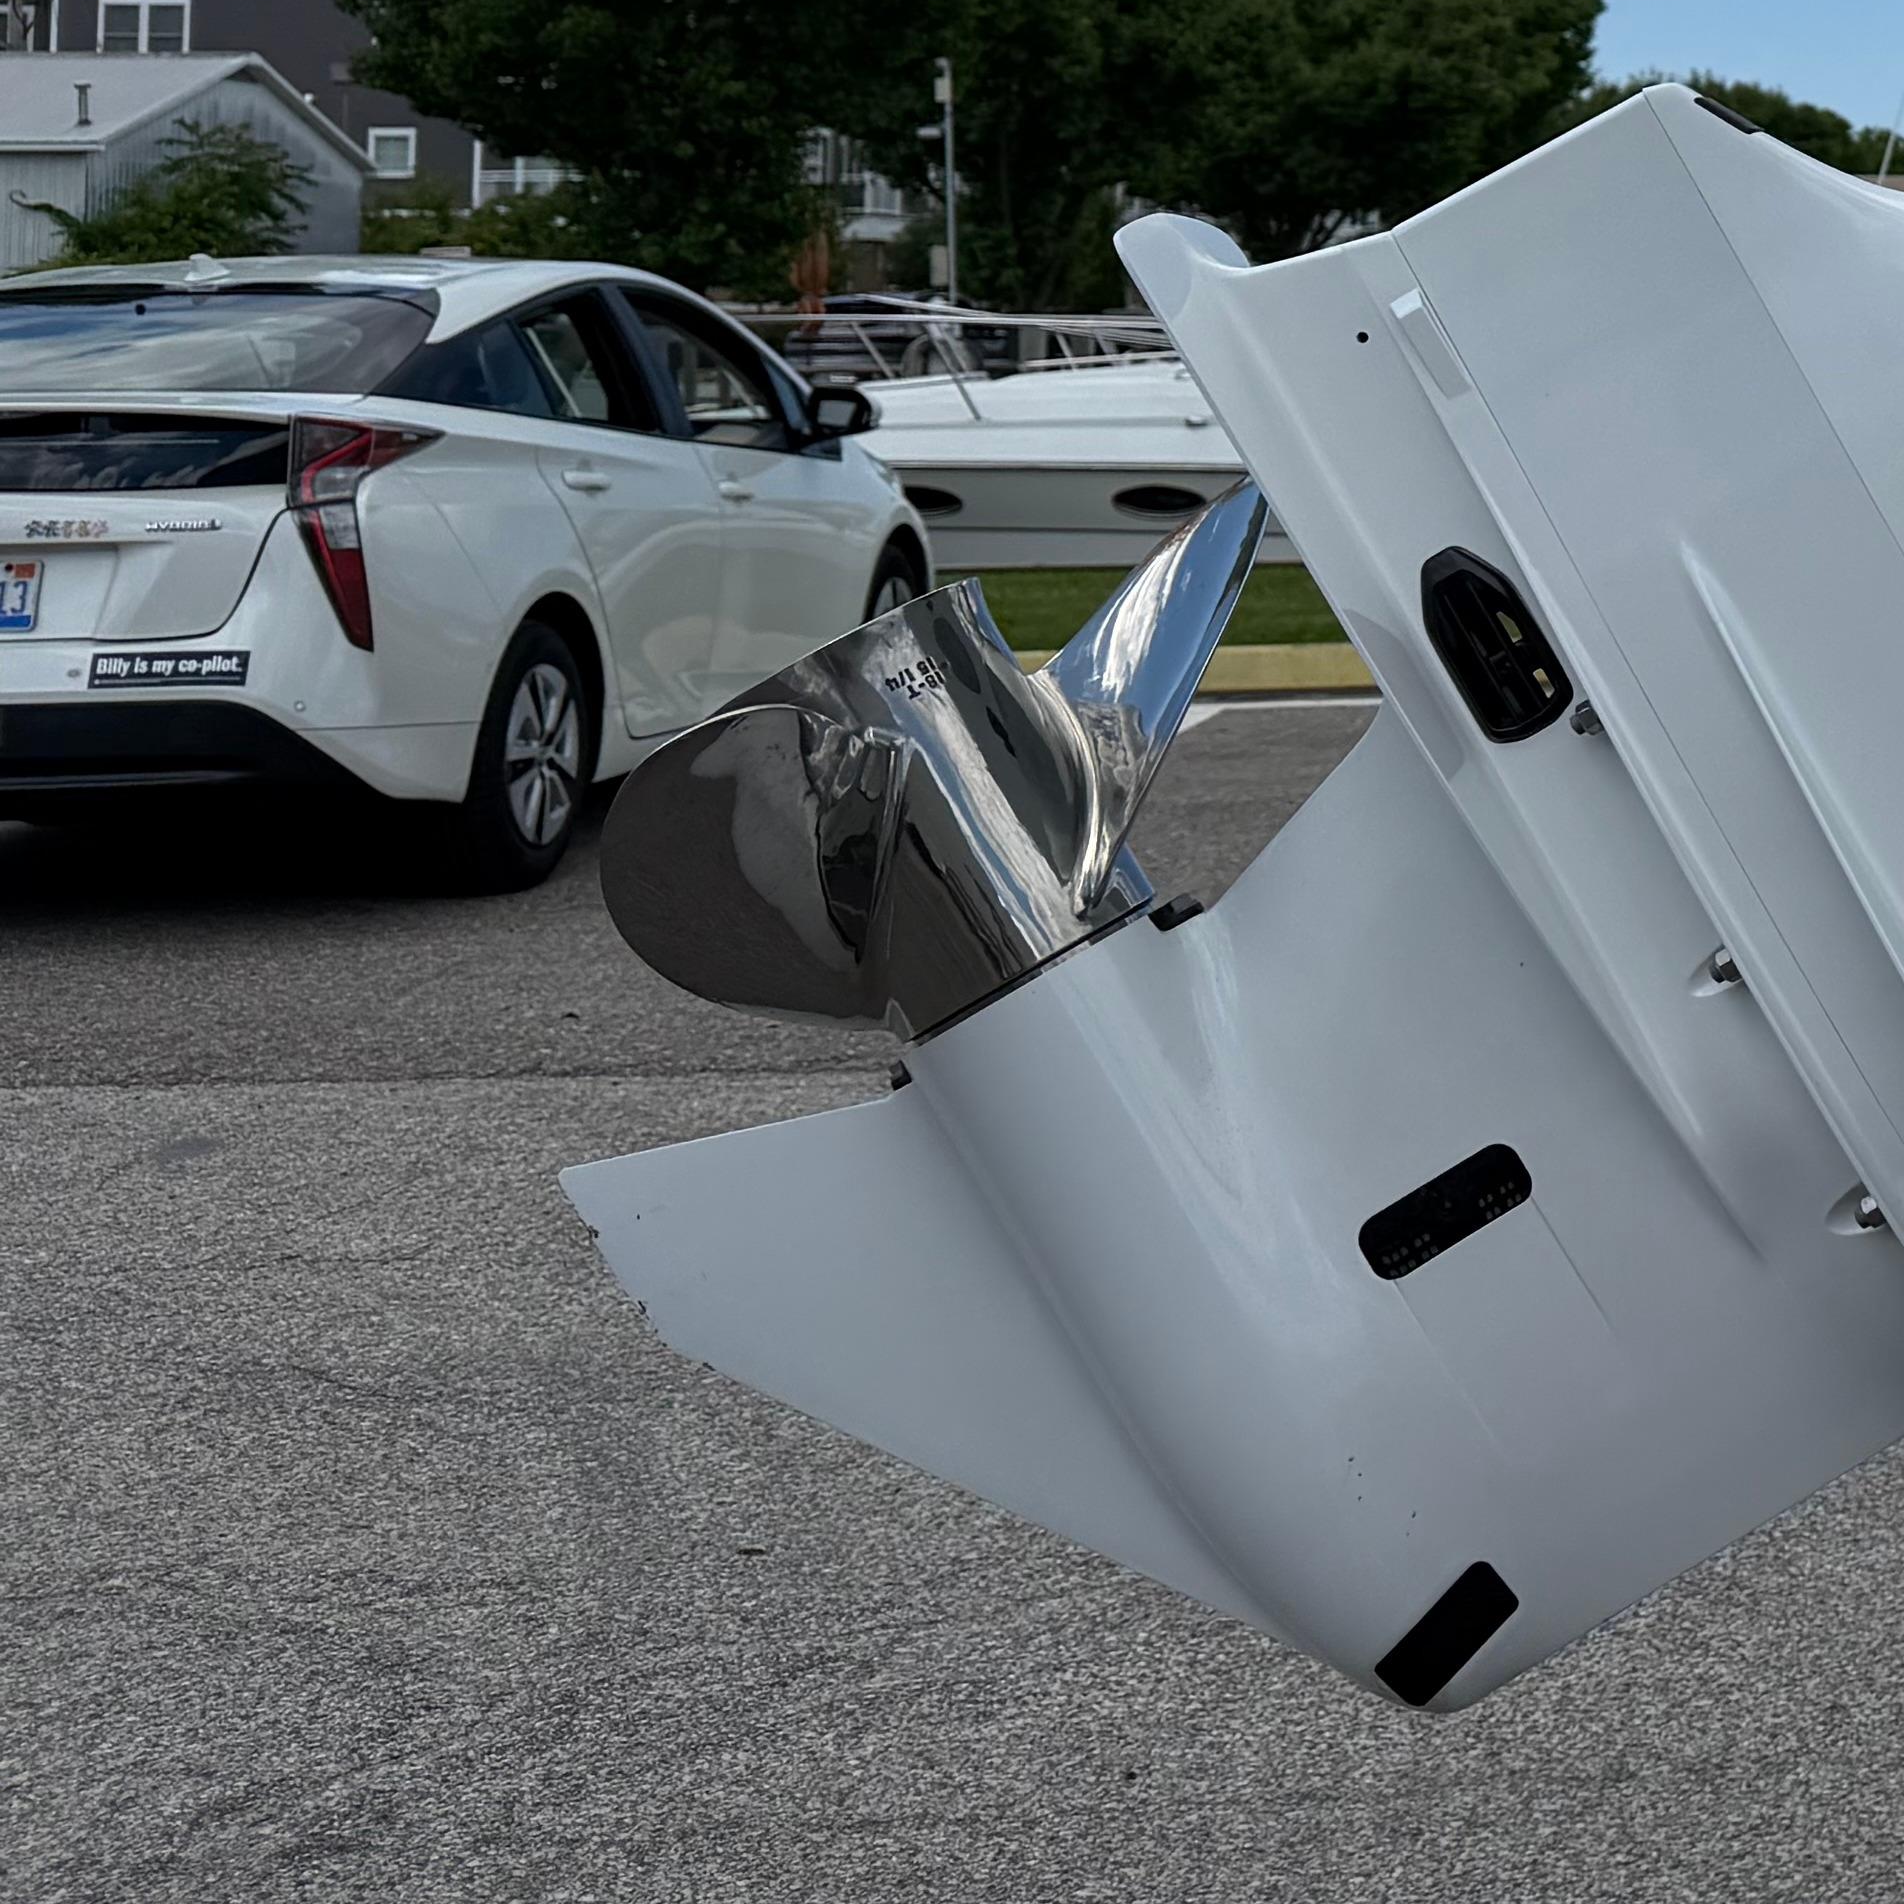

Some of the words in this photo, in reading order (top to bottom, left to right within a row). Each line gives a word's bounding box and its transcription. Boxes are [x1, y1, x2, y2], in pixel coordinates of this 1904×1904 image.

[95, 657, 131, 677] Billy
[134, 656, 148, 675] is
[152, 658, 175, 676] my
[178, 655, 242, 676] co-pilot.
